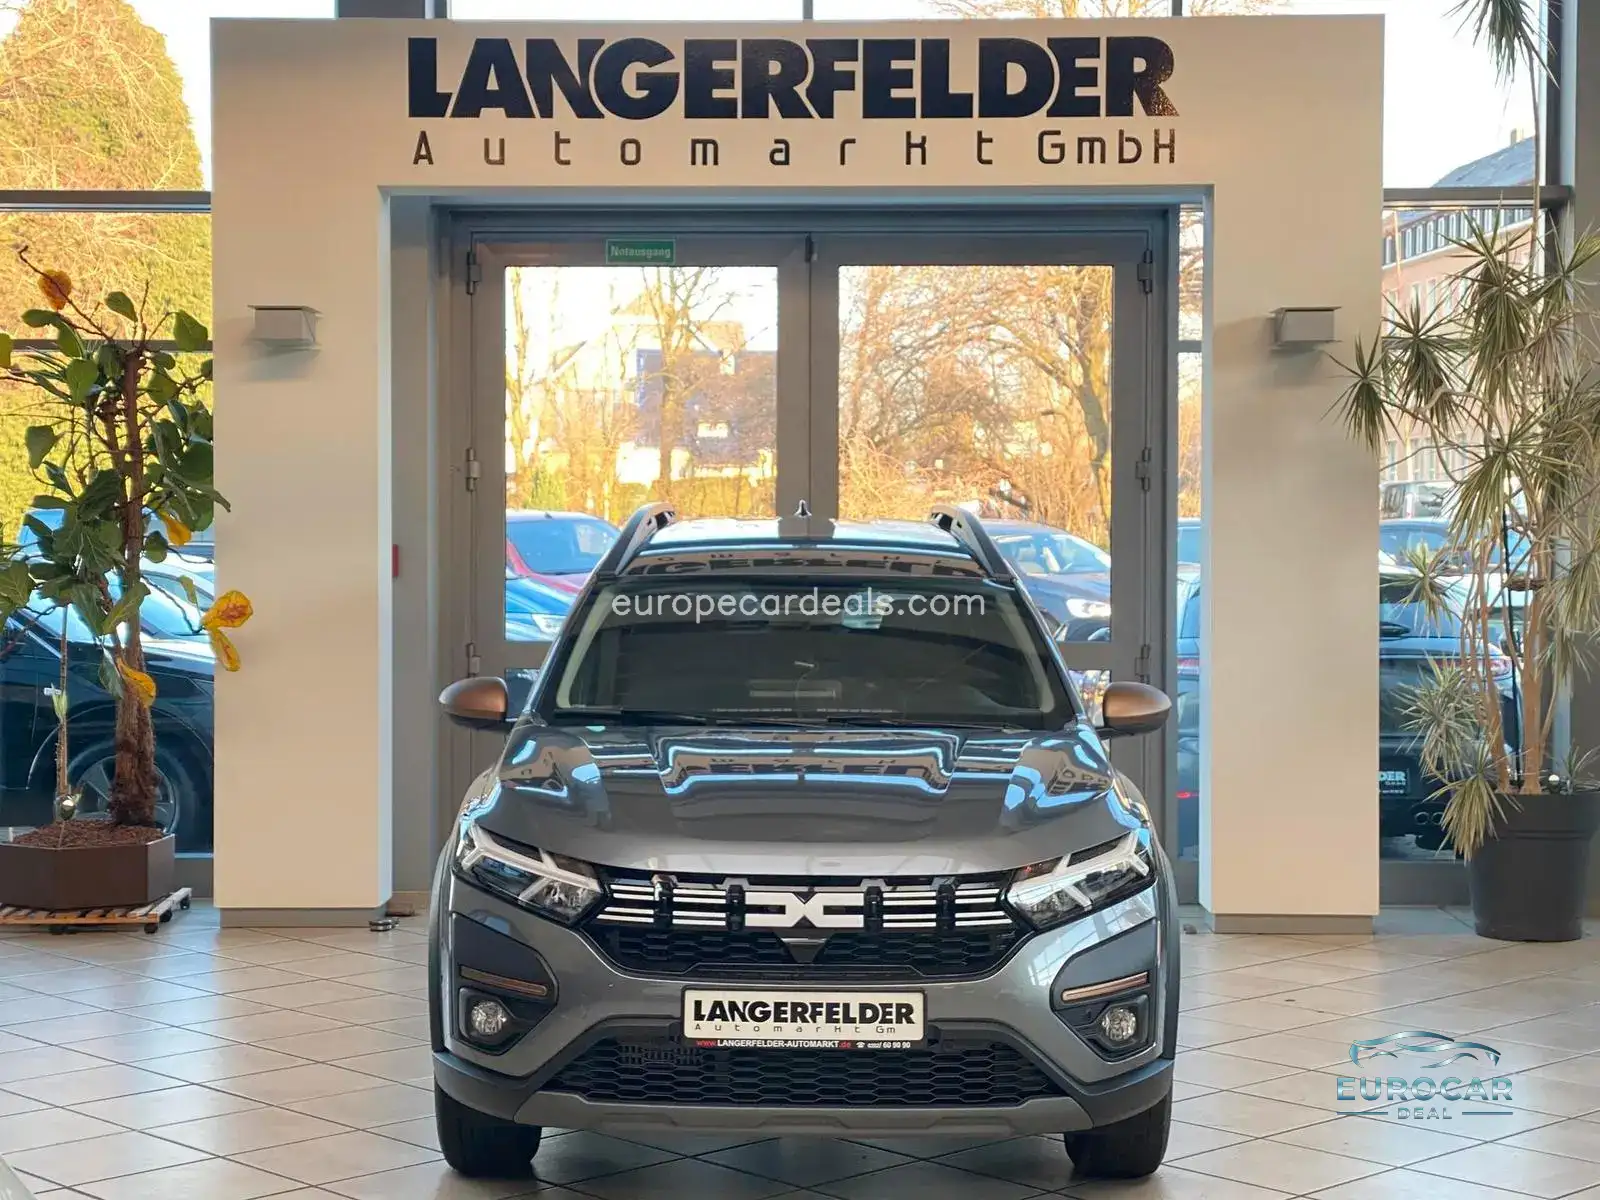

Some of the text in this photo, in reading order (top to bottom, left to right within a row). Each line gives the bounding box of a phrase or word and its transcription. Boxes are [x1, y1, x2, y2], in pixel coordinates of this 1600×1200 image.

[408, 36, 1180, 120] LANGERFELDER
[412, 128, 1176, 166] Automarkt GmbH
[610, 245, 671, 259] Notausgang
[693, 1000, 915, 1025] LANGERFELDER
